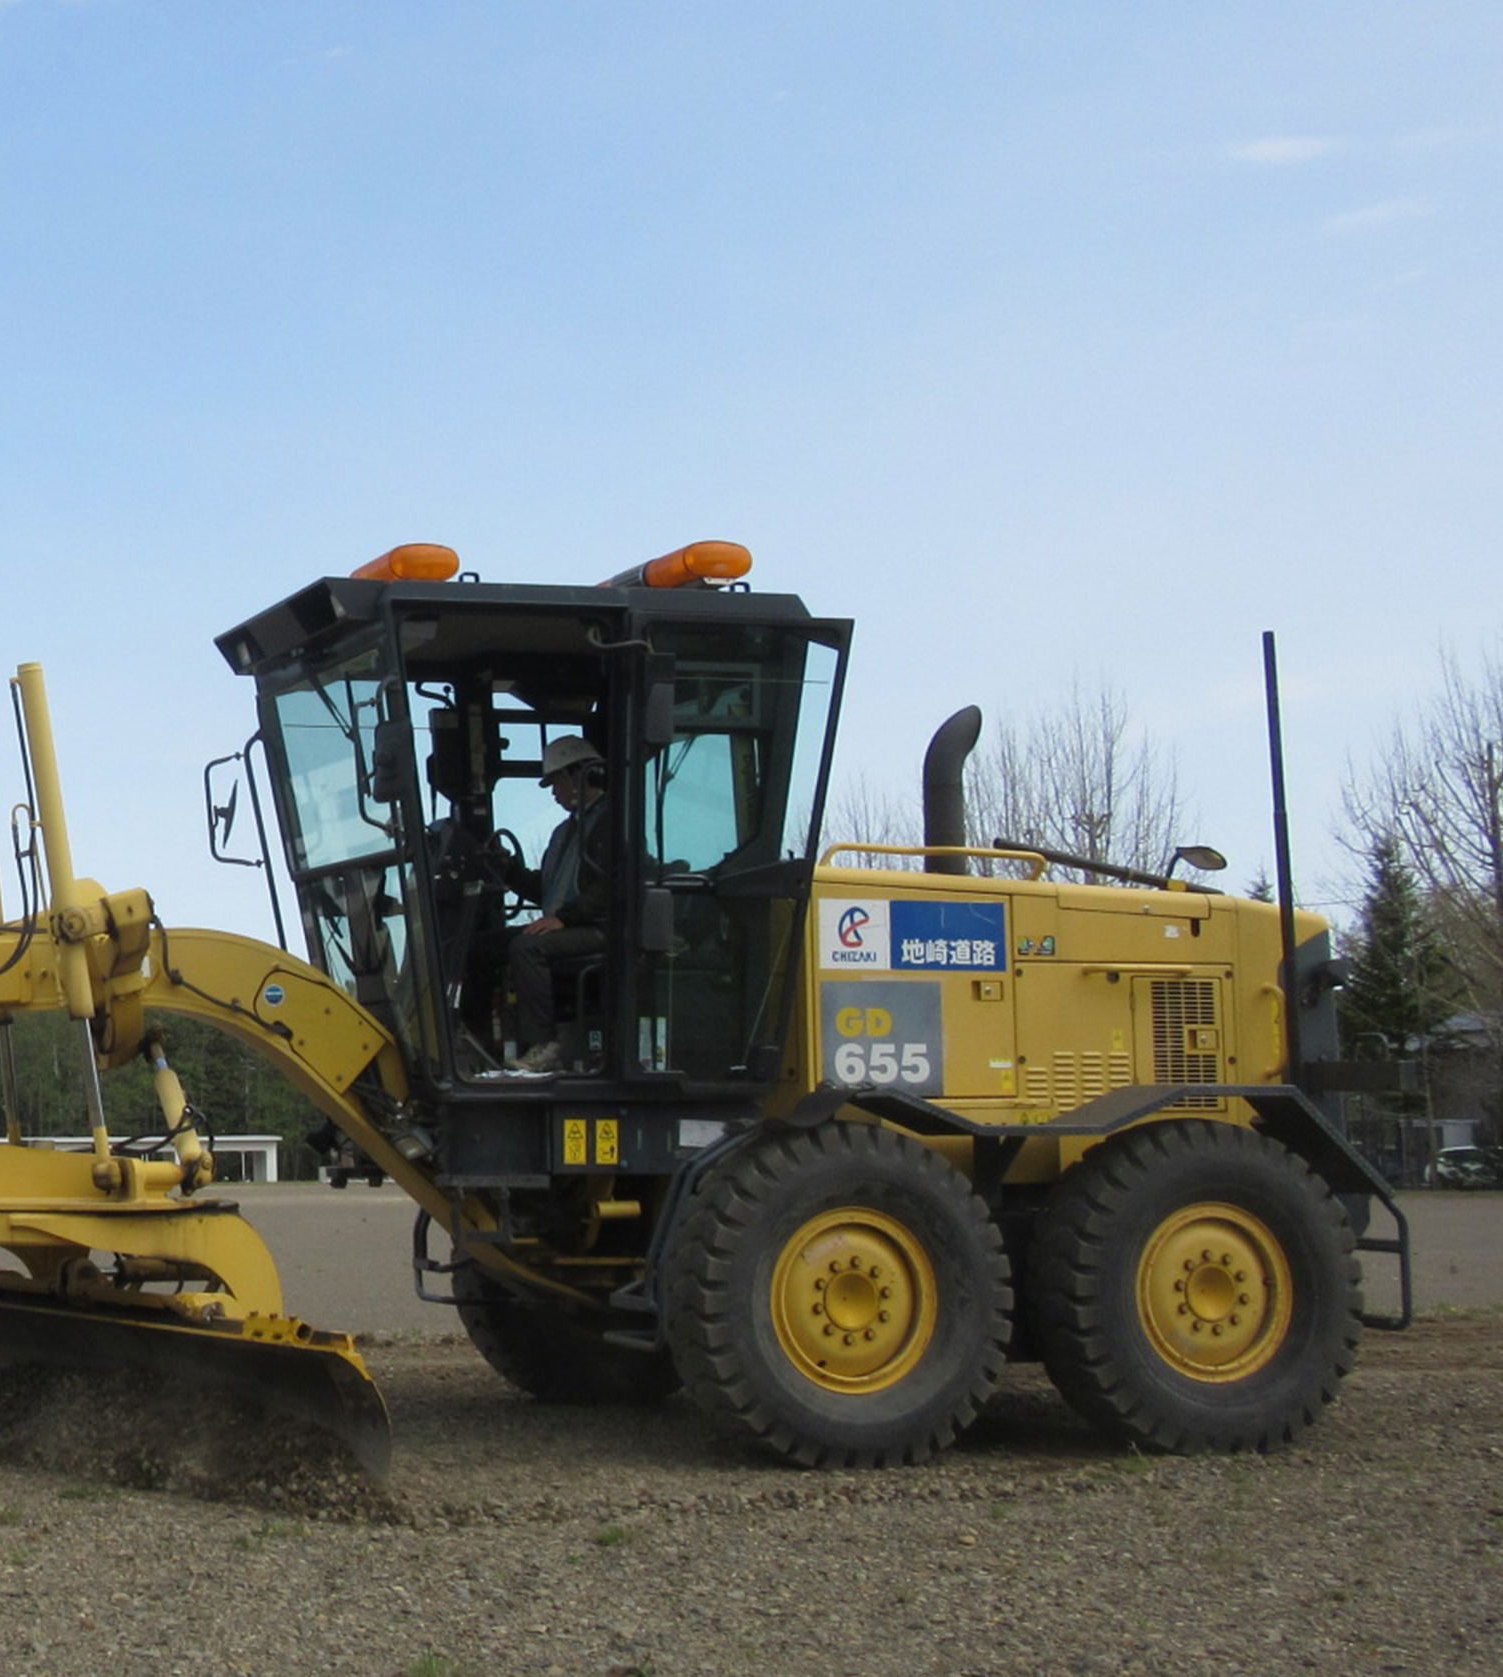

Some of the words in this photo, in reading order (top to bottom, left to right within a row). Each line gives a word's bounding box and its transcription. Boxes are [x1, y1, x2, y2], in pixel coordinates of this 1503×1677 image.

[832, 951, 877, 962] CHIZAKI
[901, 939, 996, 966] 地崎道路
[835, 1006, 893, 1037] GD
[834, 1043, 930, 1083] 655
